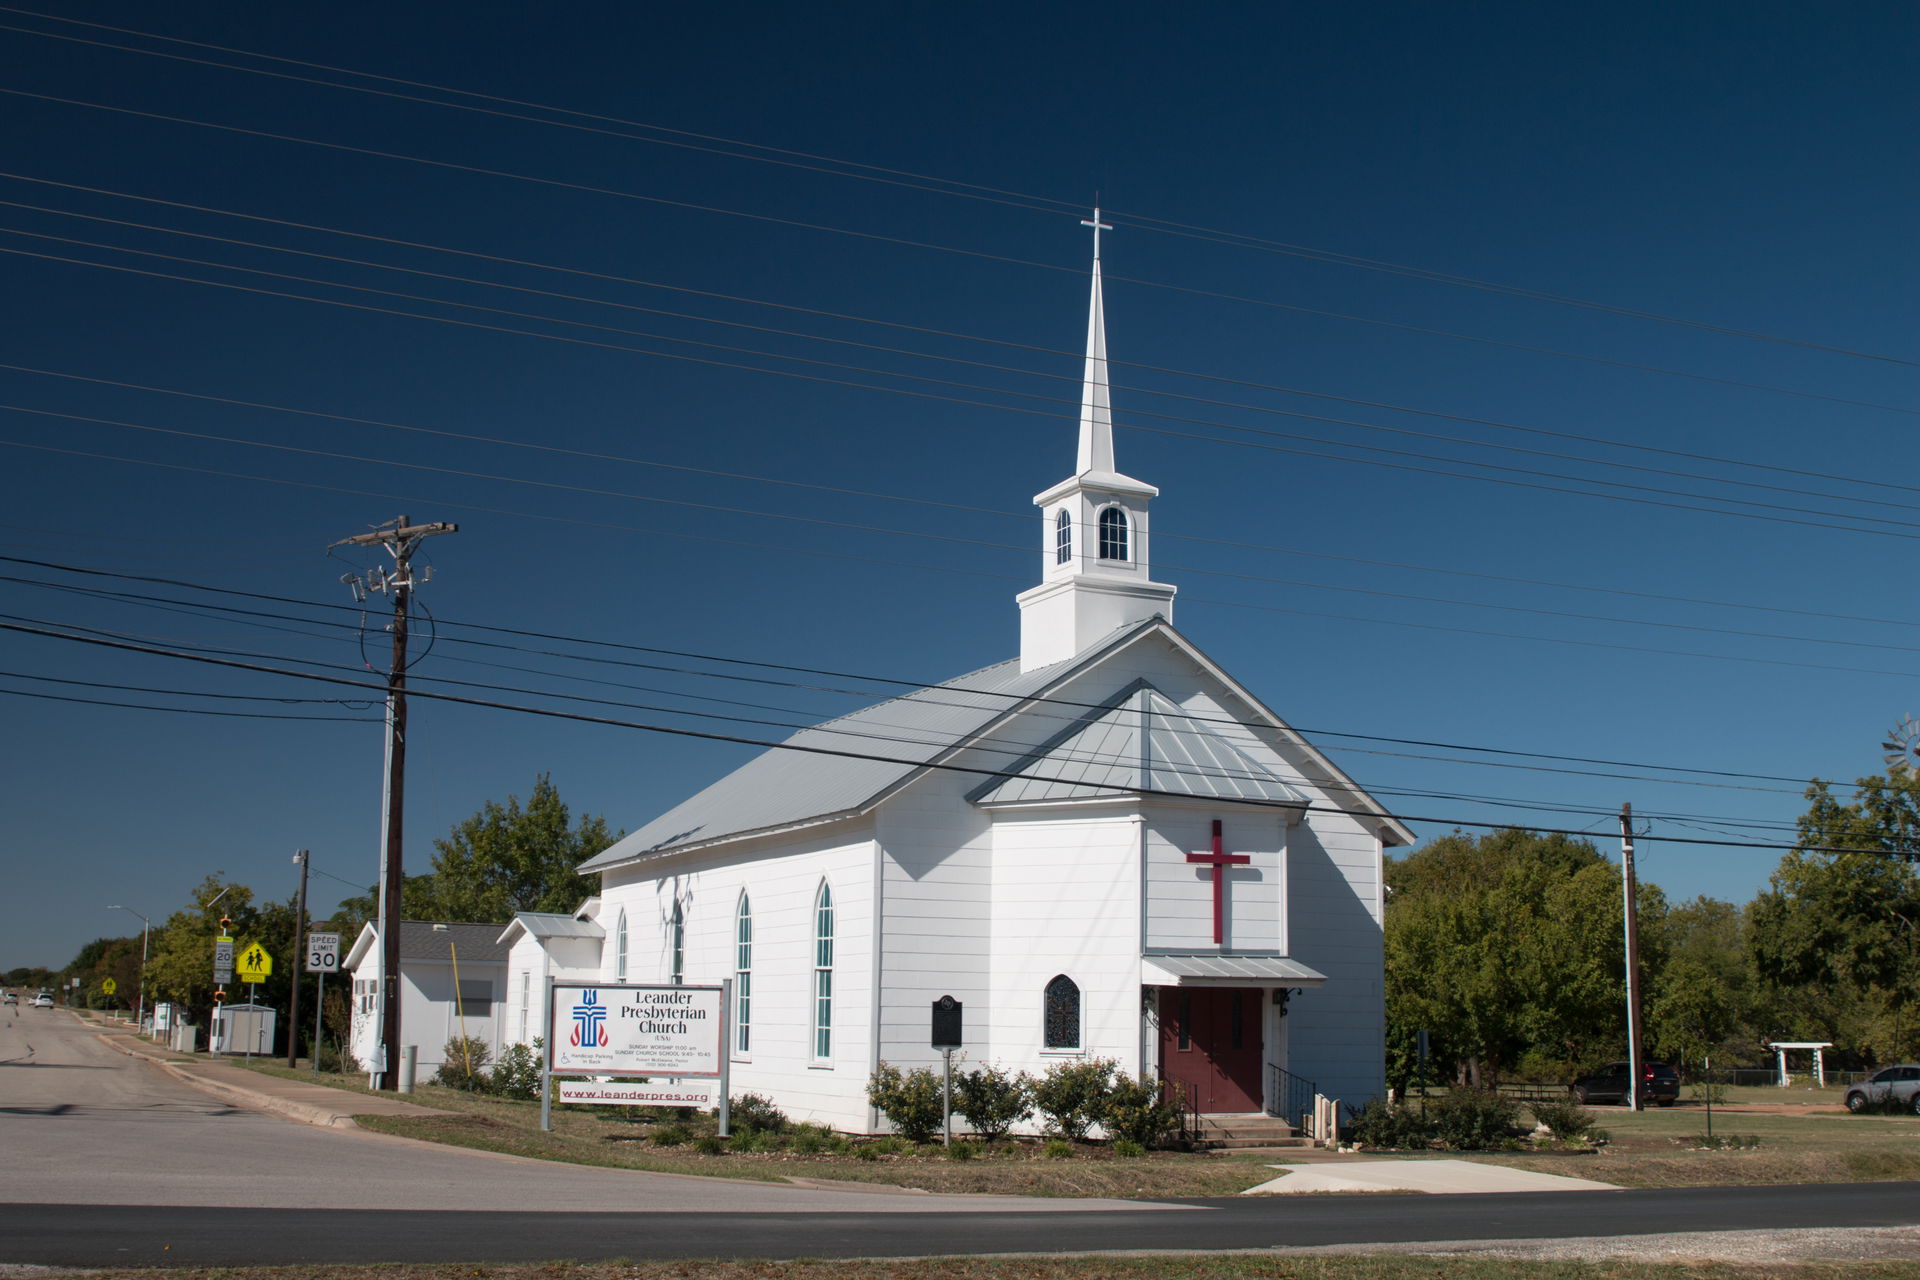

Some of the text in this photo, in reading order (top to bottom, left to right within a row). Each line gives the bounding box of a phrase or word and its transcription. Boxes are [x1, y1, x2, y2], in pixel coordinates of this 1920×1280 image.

[311, 936, 337, 944] SPEED
[217, 953, 231, 961] 20
[310, 952, 335, 967] 30
[636, 991, 693, 1004] Leander
[621, 1005, 706, 1021] Presbyterian
[639, 1020, 687, 1034] Church
[562, 1090, 709, 1103] www.leanderpres.org
